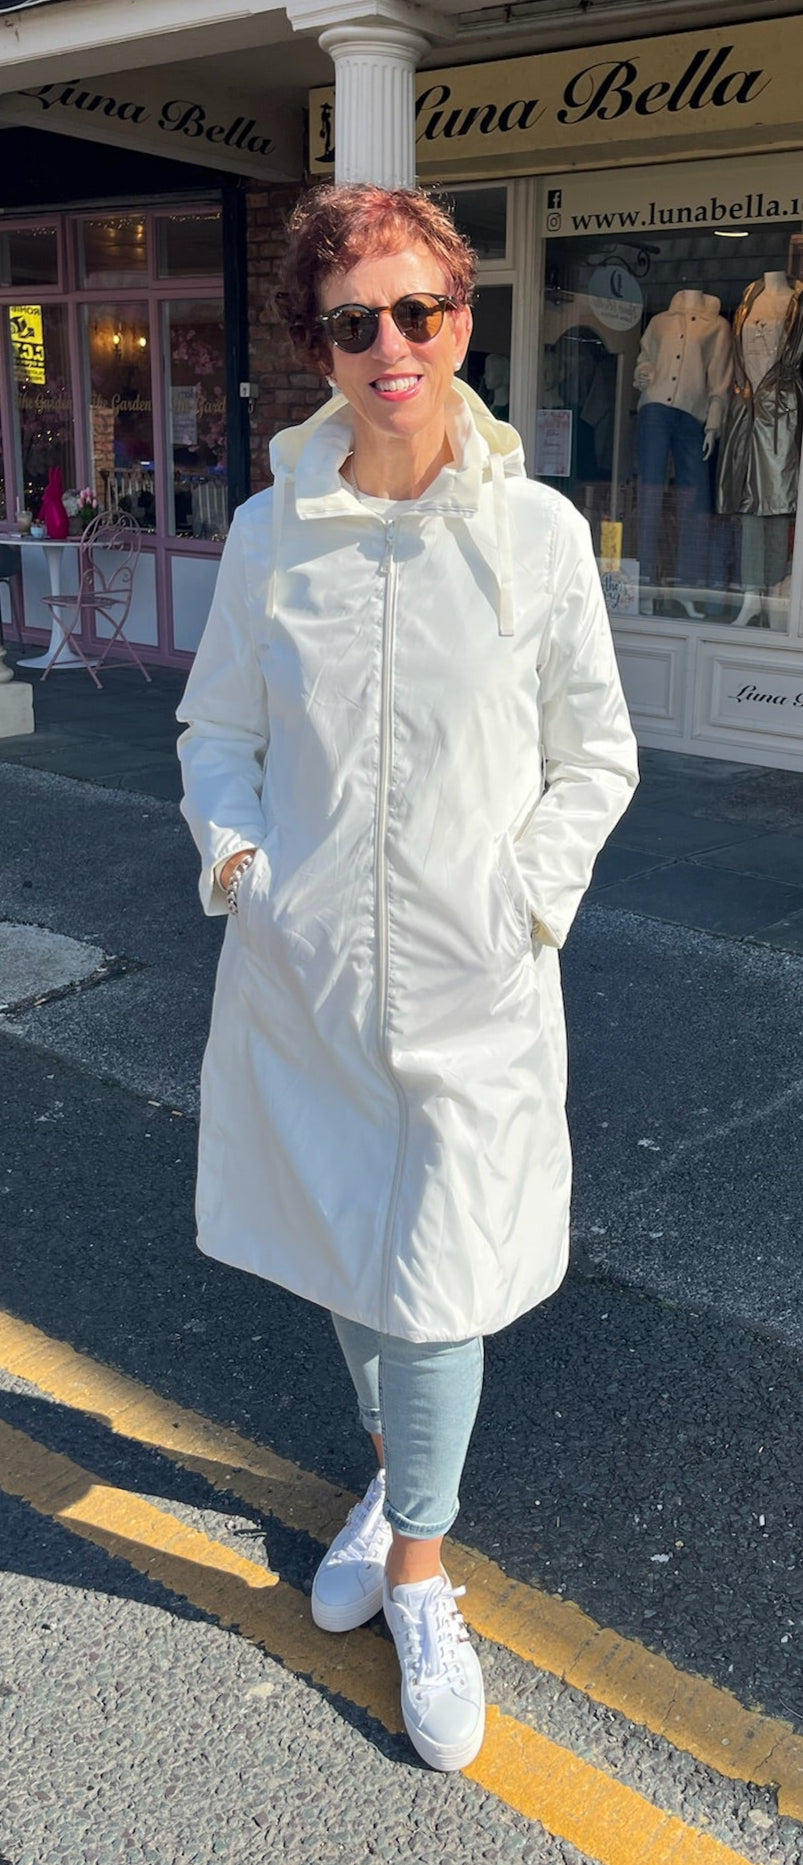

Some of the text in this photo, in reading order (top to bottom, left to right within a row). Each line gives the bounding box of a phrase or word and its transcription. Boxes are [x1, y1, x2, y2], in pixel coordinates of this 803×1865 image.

[556, 46, 772, 125] Bella
[158, 100, 276, 156] Bella
[112, 393, 153, 416] Garden
[728, 685, 787, 705] Luna
